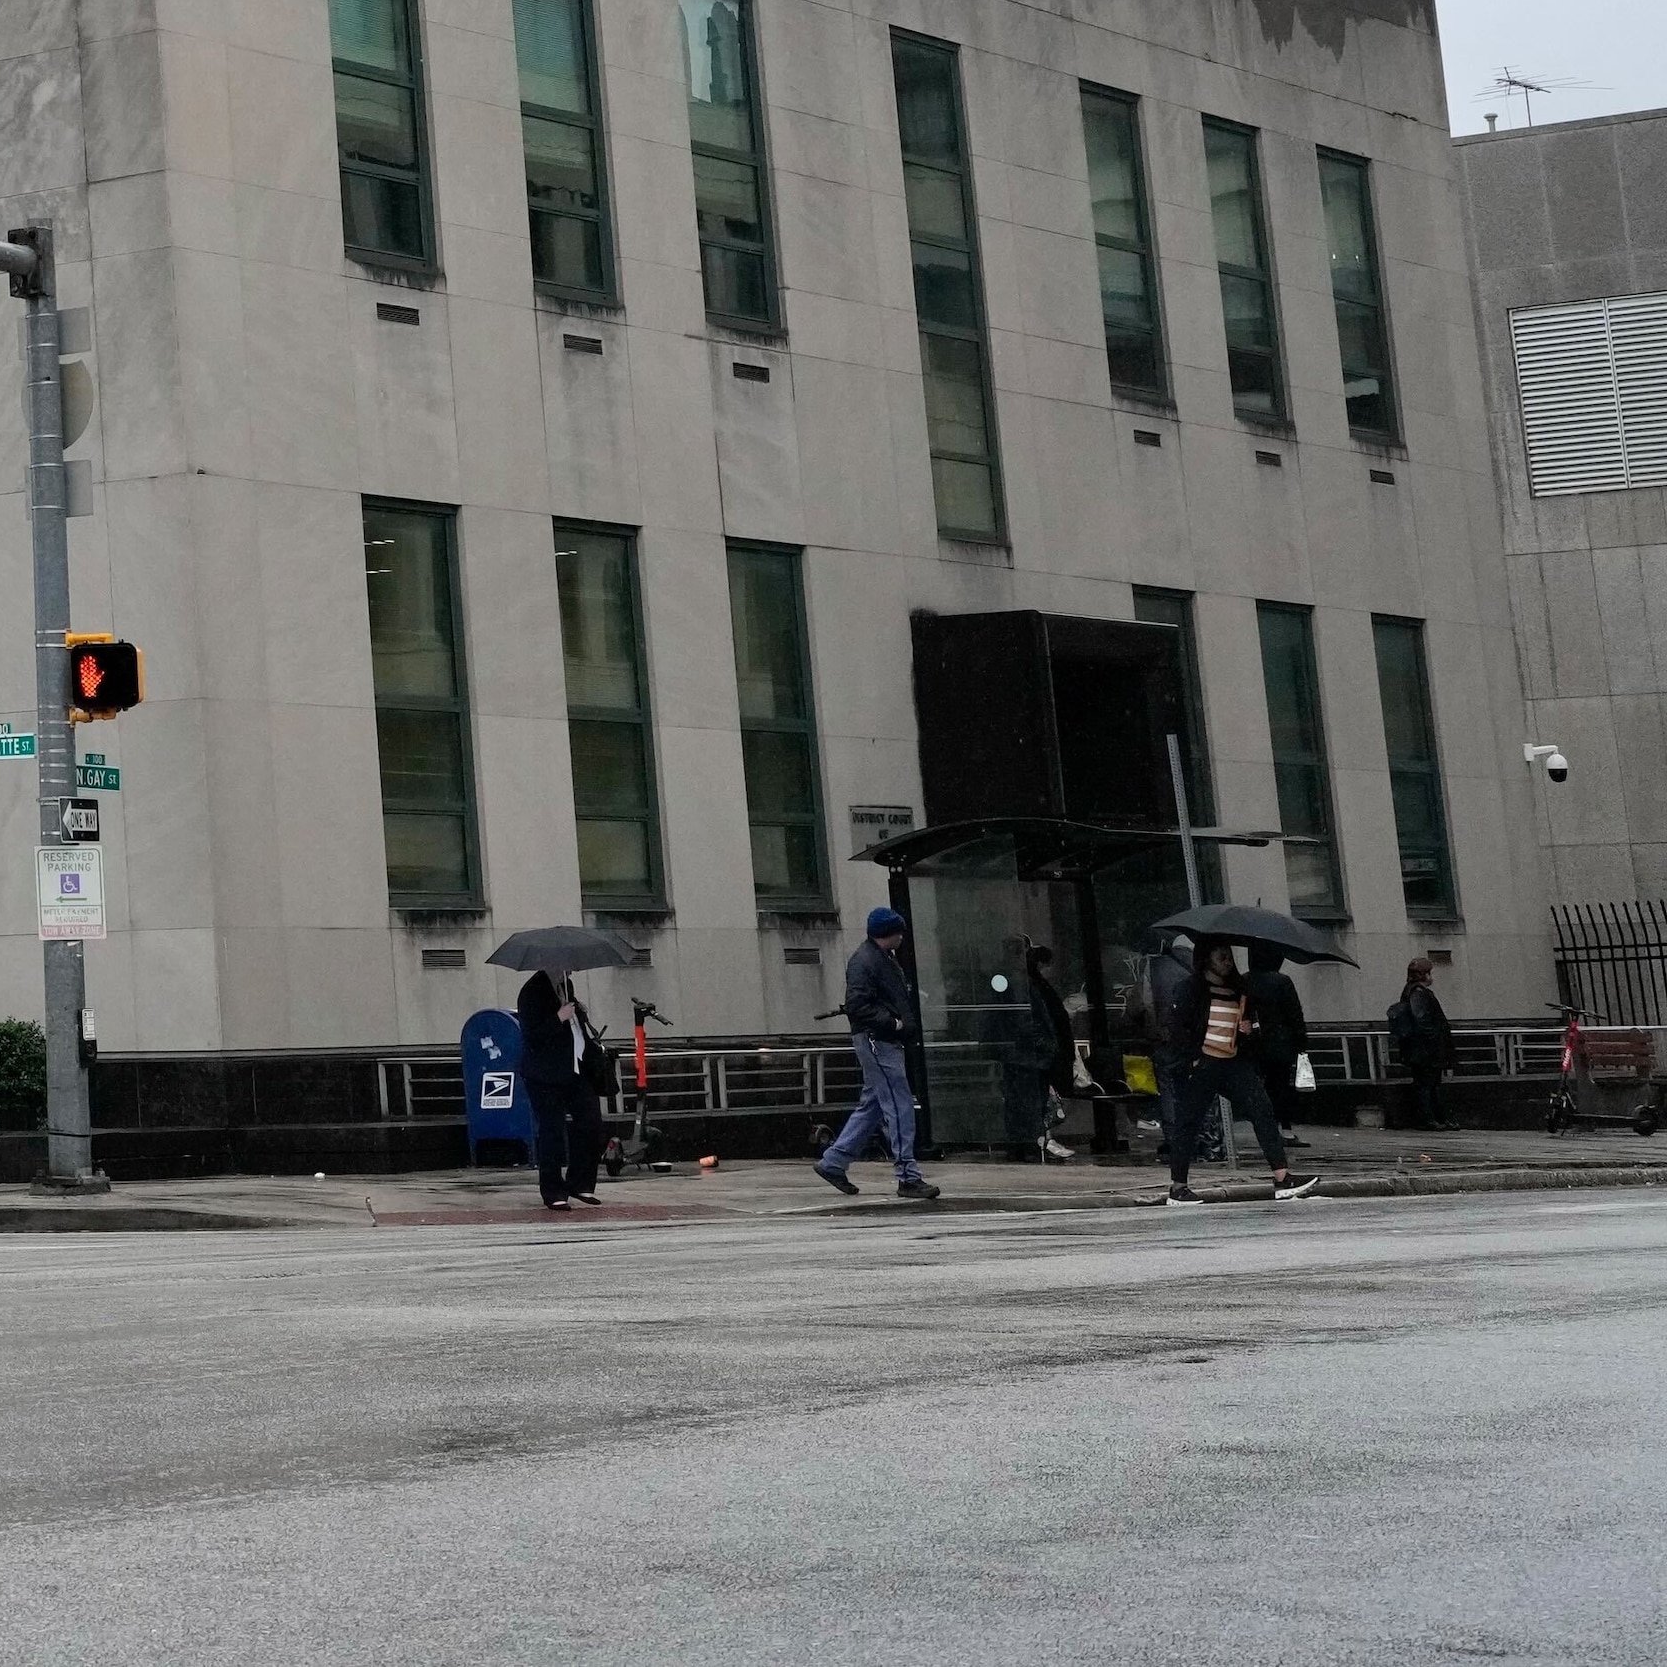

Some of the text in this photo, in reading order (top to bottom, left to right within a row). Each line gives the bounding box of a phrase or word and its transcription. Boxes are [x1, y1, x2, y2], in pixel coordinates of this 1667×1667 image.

[21, 741, 32, 751] ST.
[71, 811, 97, 829] ONE WAY
[43, 852, 94, 862] RESERVED
[47, 863, 92, 872] PARKING
